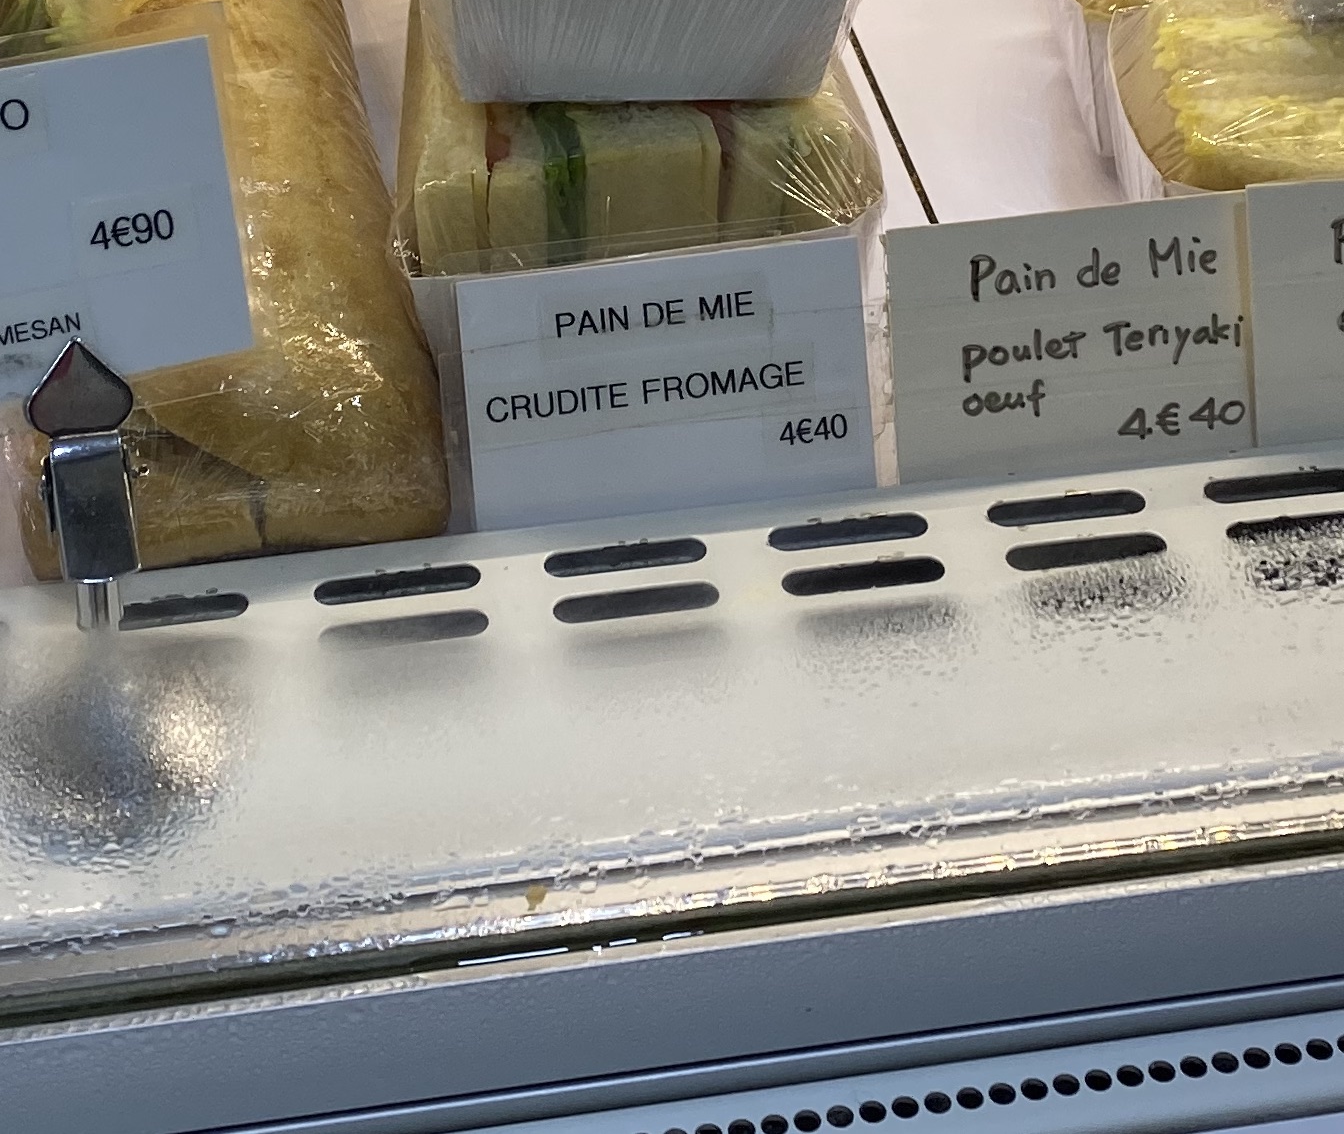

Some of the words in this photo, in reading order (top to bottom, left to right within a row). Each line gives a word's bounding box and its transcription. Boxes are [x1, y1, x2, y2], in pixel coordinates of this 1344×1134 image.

[88, 208, 176, 251] 4€90
[969, 253, 1057, 303] Pain
[1076, 247, 1122, 288] de
[1148, 235, 1218, 279] Mie
[554, 304, 630, 339] PAIN
[642, 298, 686, 329] DE
[699, 290, 756, 322] MIE
[961, 328, 1087, 384] poulet
[485, 382, 630, 423] CRUDITE
[642, 360, 806, 406] FROMAGE
[961, 378, 1047, 418] oeuf
[778, 412, 849, 447] 4€40
